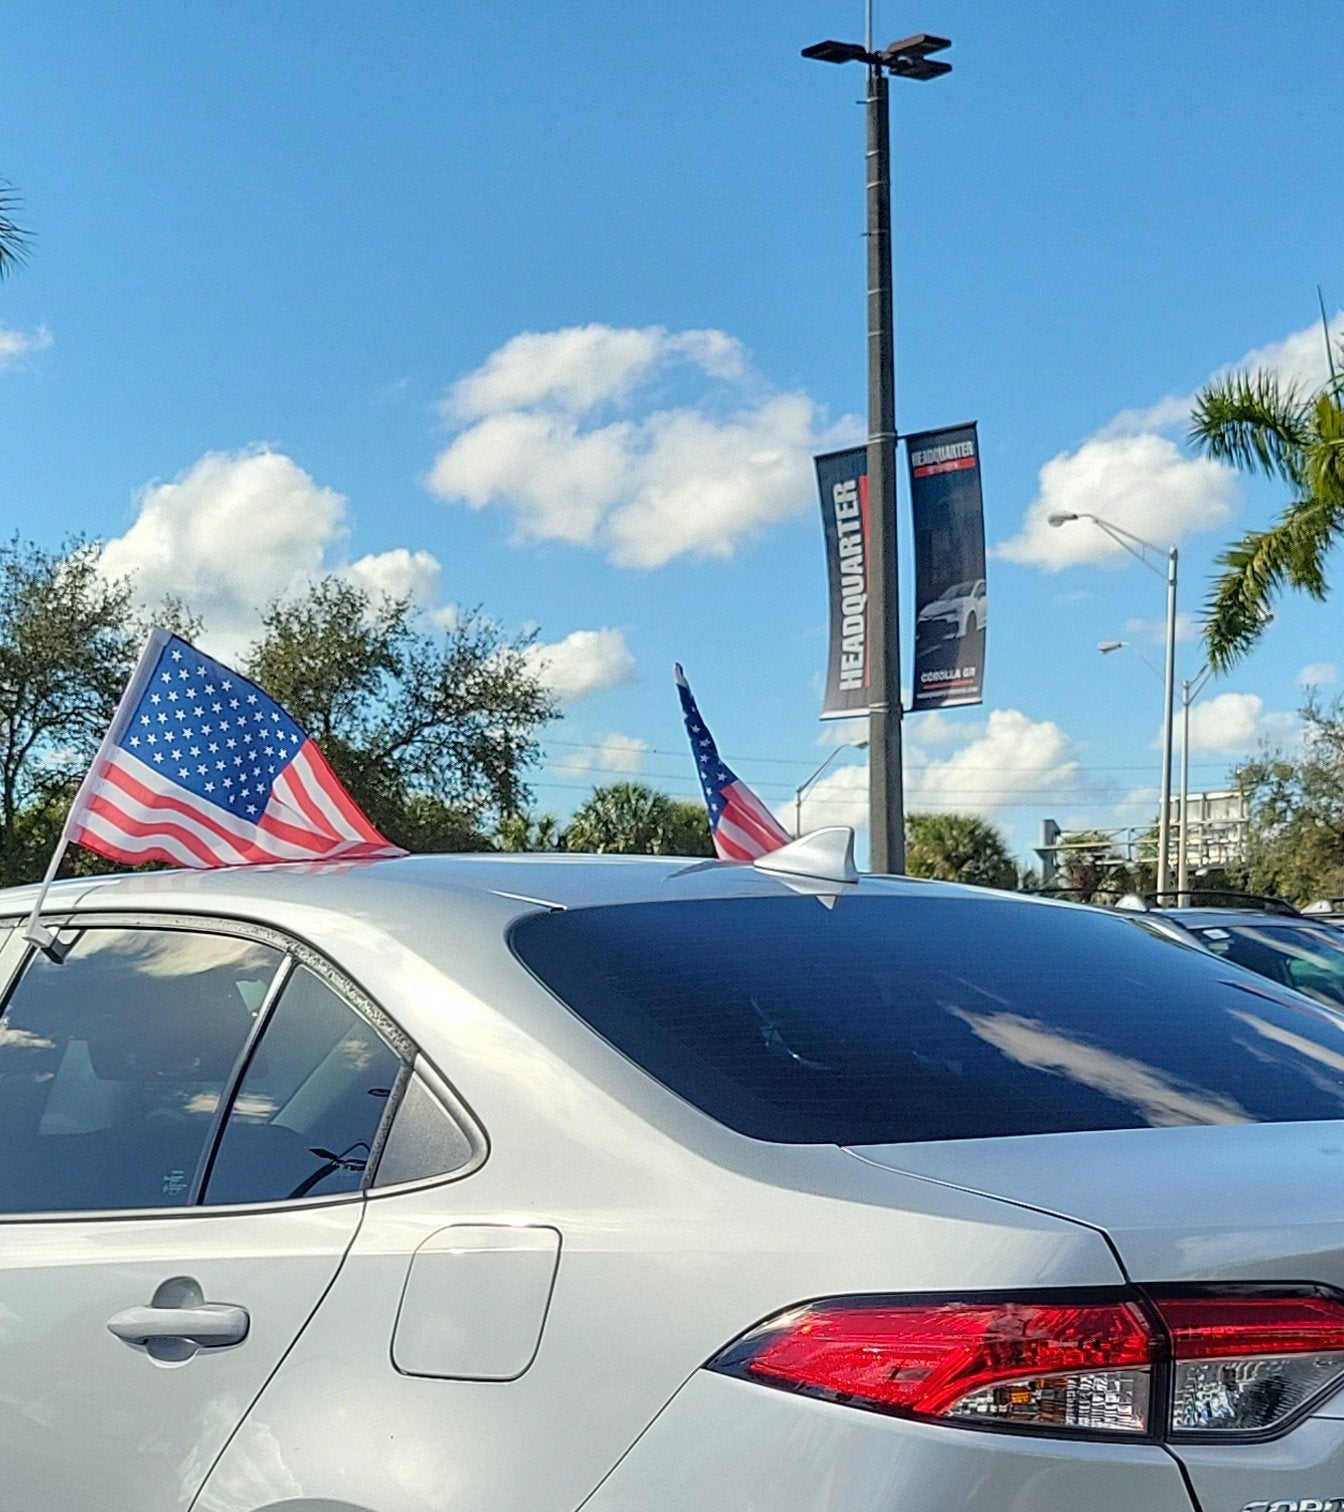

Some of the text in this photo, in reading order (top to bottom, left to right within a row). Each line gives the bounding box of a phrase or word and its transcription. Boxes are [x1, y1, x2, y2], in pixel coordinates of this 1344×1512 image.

[912, 441, 974, 467] HEADQUARTER
[832, 479, 868, 691] HEADQUARTER
[921, 669, 961, 682] COROLLA
